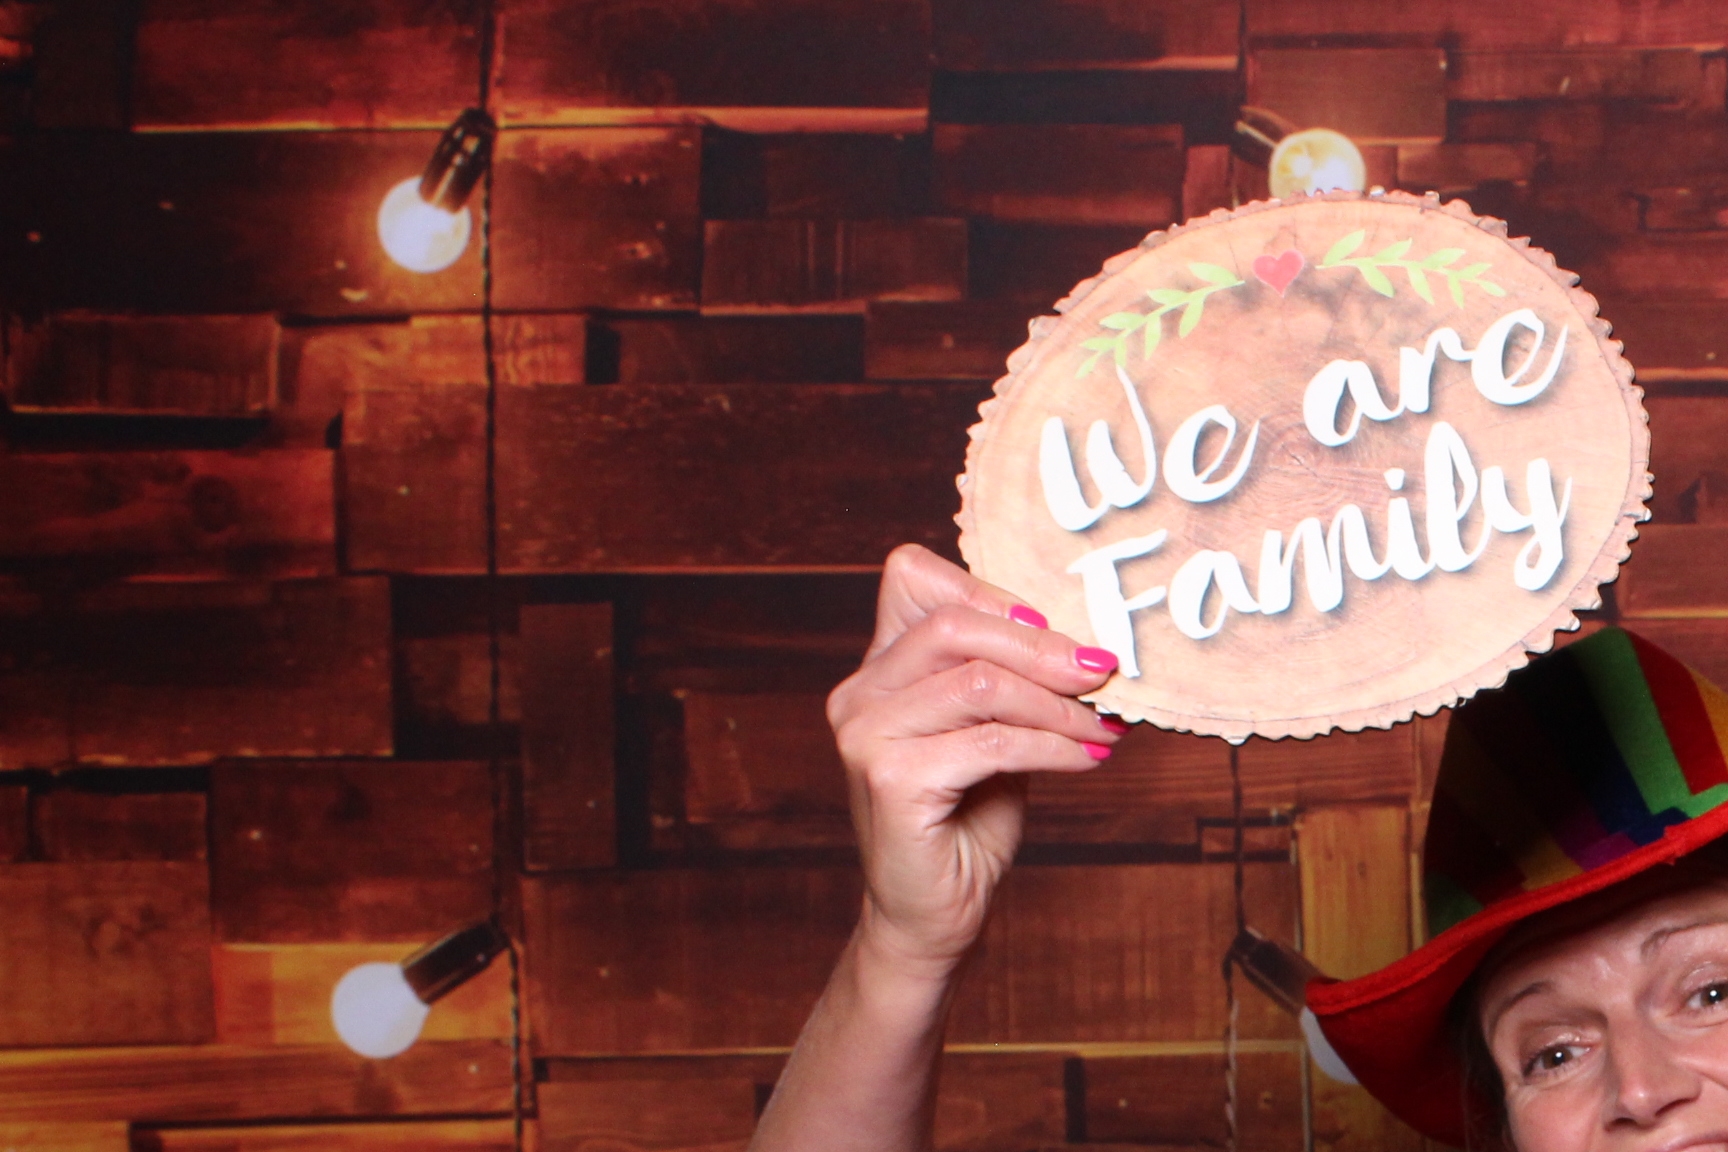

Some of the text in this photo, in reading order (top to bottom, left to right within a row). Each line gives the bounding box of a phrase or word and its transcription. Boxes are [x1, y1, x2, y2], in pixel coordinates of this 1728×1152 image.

[1038, 308, 1569, 532] We are
[1066, 421, 1573, 679] Family
